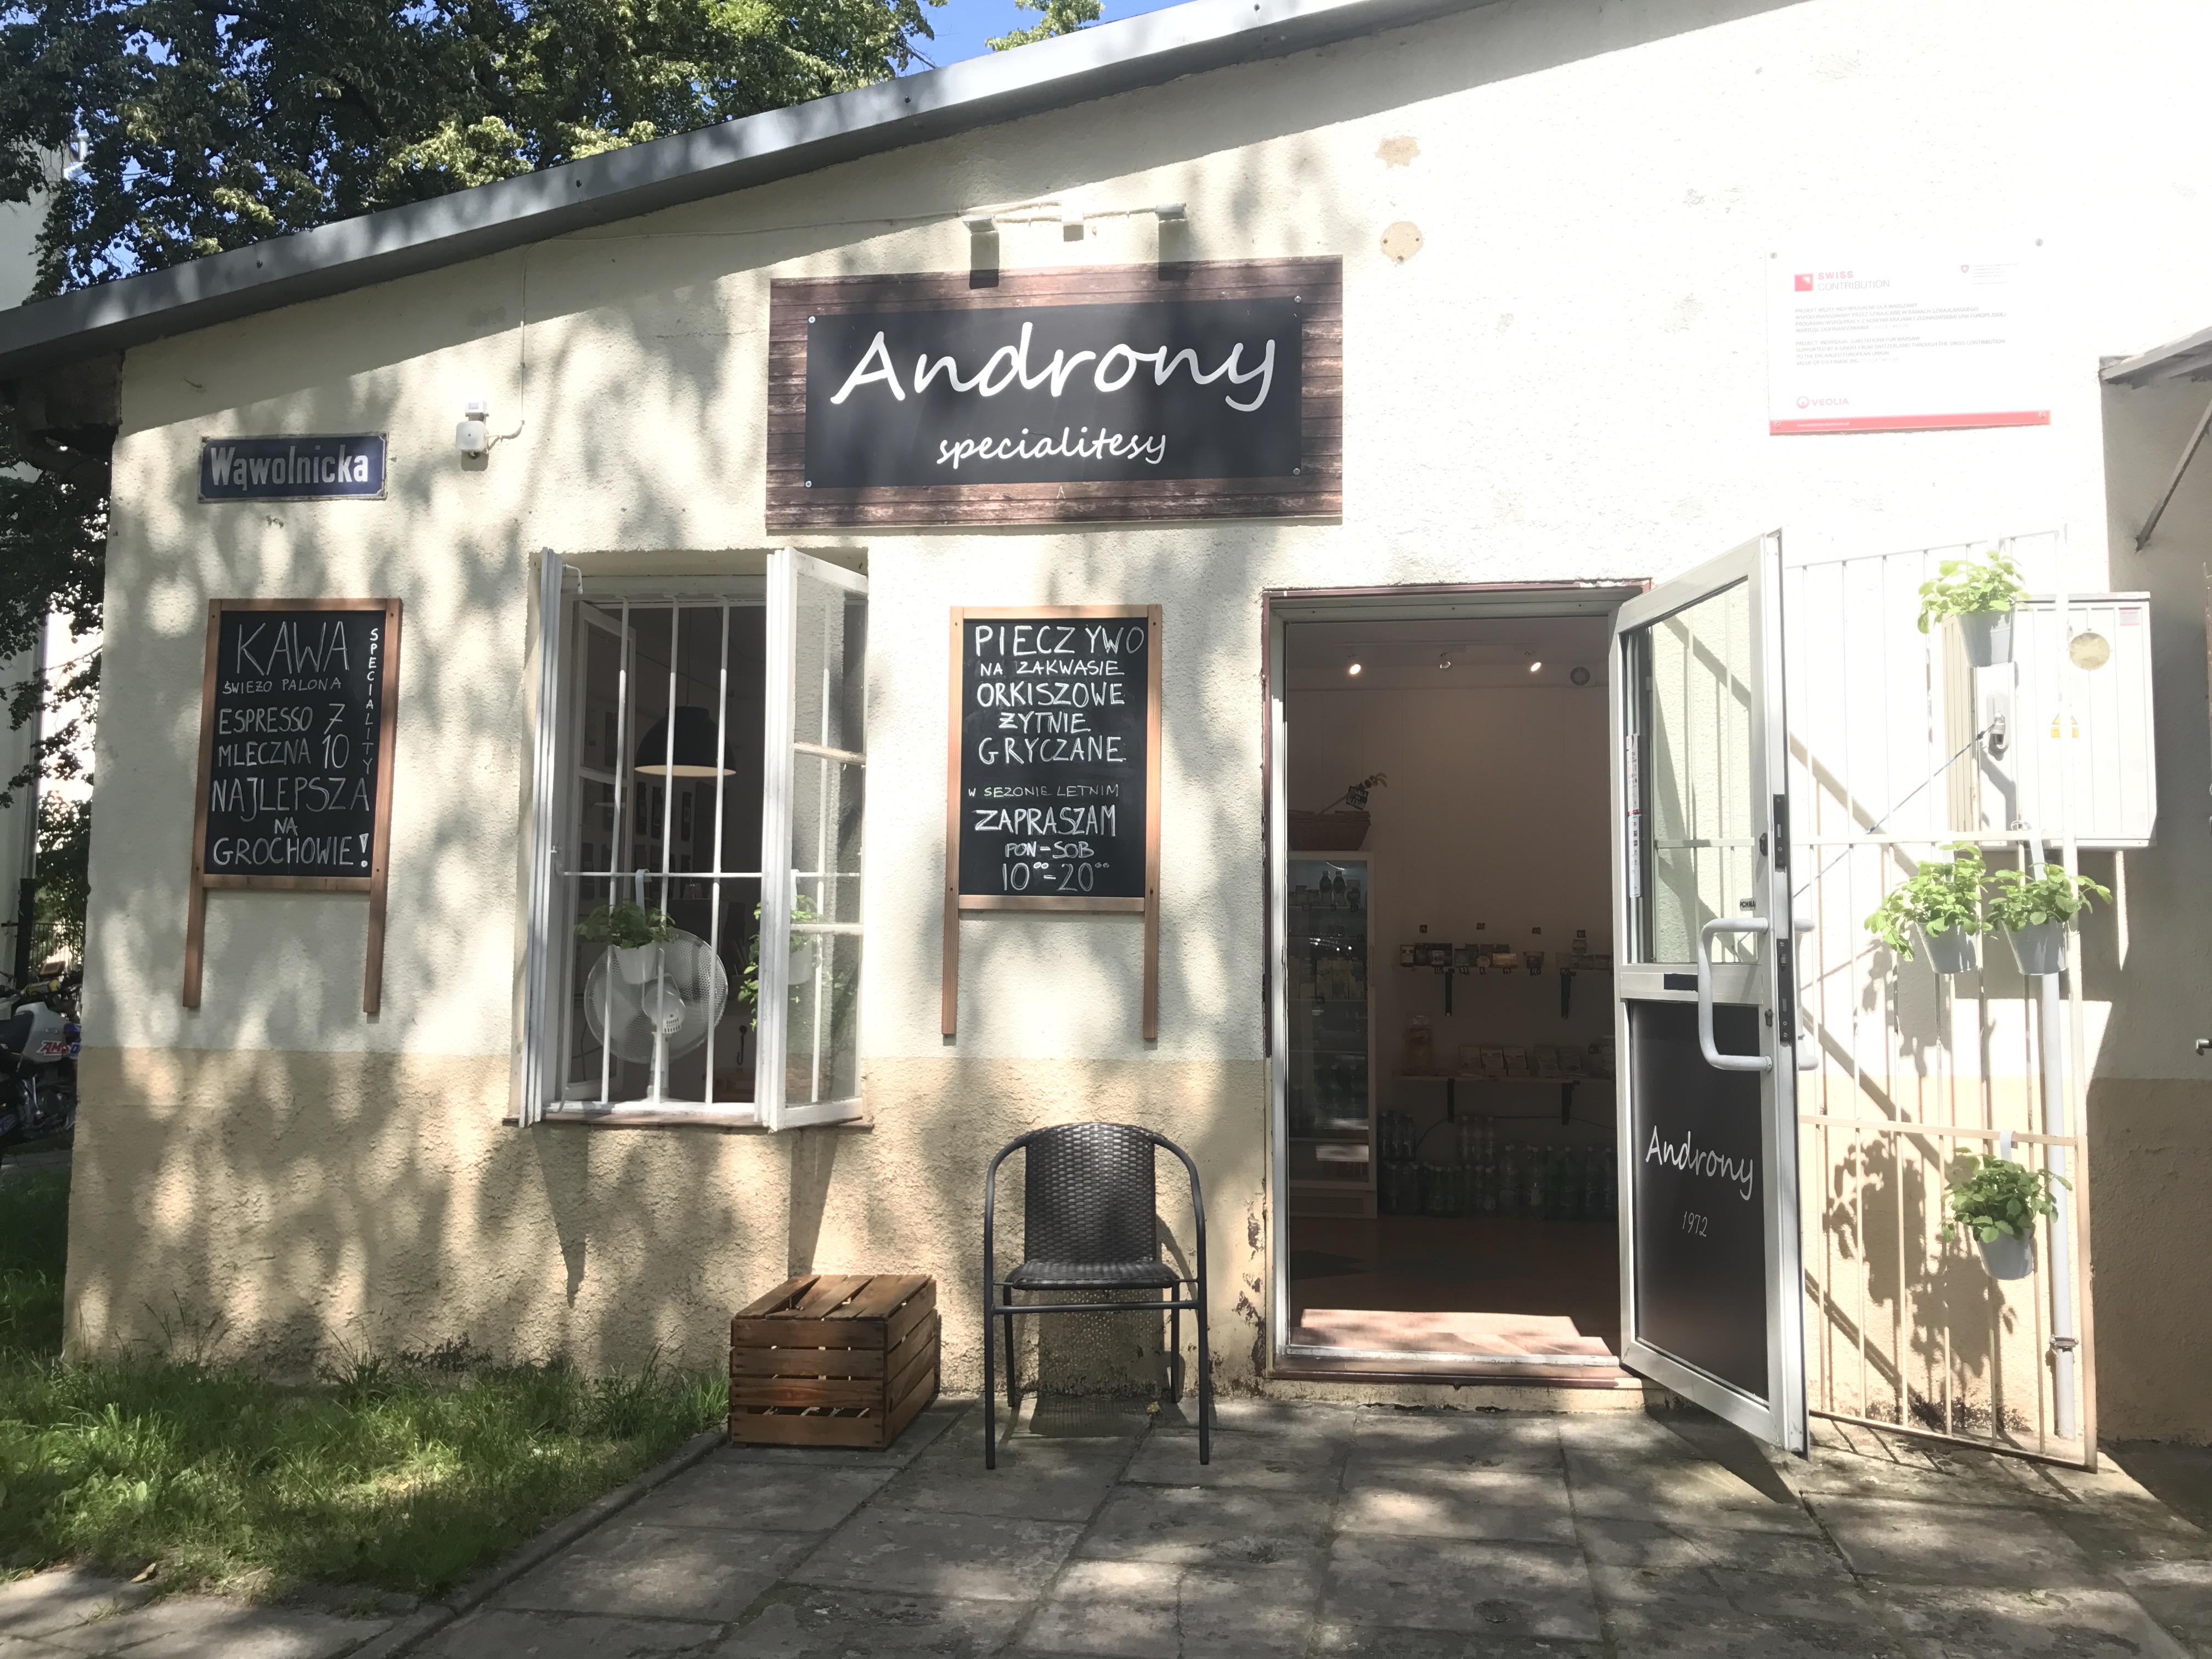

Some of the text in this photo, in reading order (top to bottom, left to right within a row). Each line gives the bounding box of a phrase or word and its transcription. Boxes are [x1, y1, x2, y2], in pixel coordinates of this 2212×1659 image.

[1818, 271, 1854, 279] SWISS
[1818, 280, 1889, 291] CONTRIBUTION
[830, 321, 1275, 413] Androny
[936, 426, 1166, 469] specialitesy
[211, 444, 369, 491] Wąwolnicka
[237, 621, 349, 676] KAWA
[975, 625, 1144, 656] PIECZYWO
[980, 659, 1124, 676] NA ZAKWASIE
[283, 678, 341, 691] PALONA
[977, 681, 1125, 708] ORKISZOWE
[219, 703, 346, 735] ESPRESSO 7
[218, 734, 349, 769] MLECZNA 10
[979, 735, 1126, 765] GRYCZANE
[212, 777, 369, 822] NAJLEPSZA
[968, 784, 1118, 797] W SEZONIE LETNIM
[274, 817, 298, 836] NA
[971, 805, 1116, 836] ZAPRASZAM
[1646, 1125, 1752, 1200] Androny
[1683, 1211, 1707, 1237] 1972
